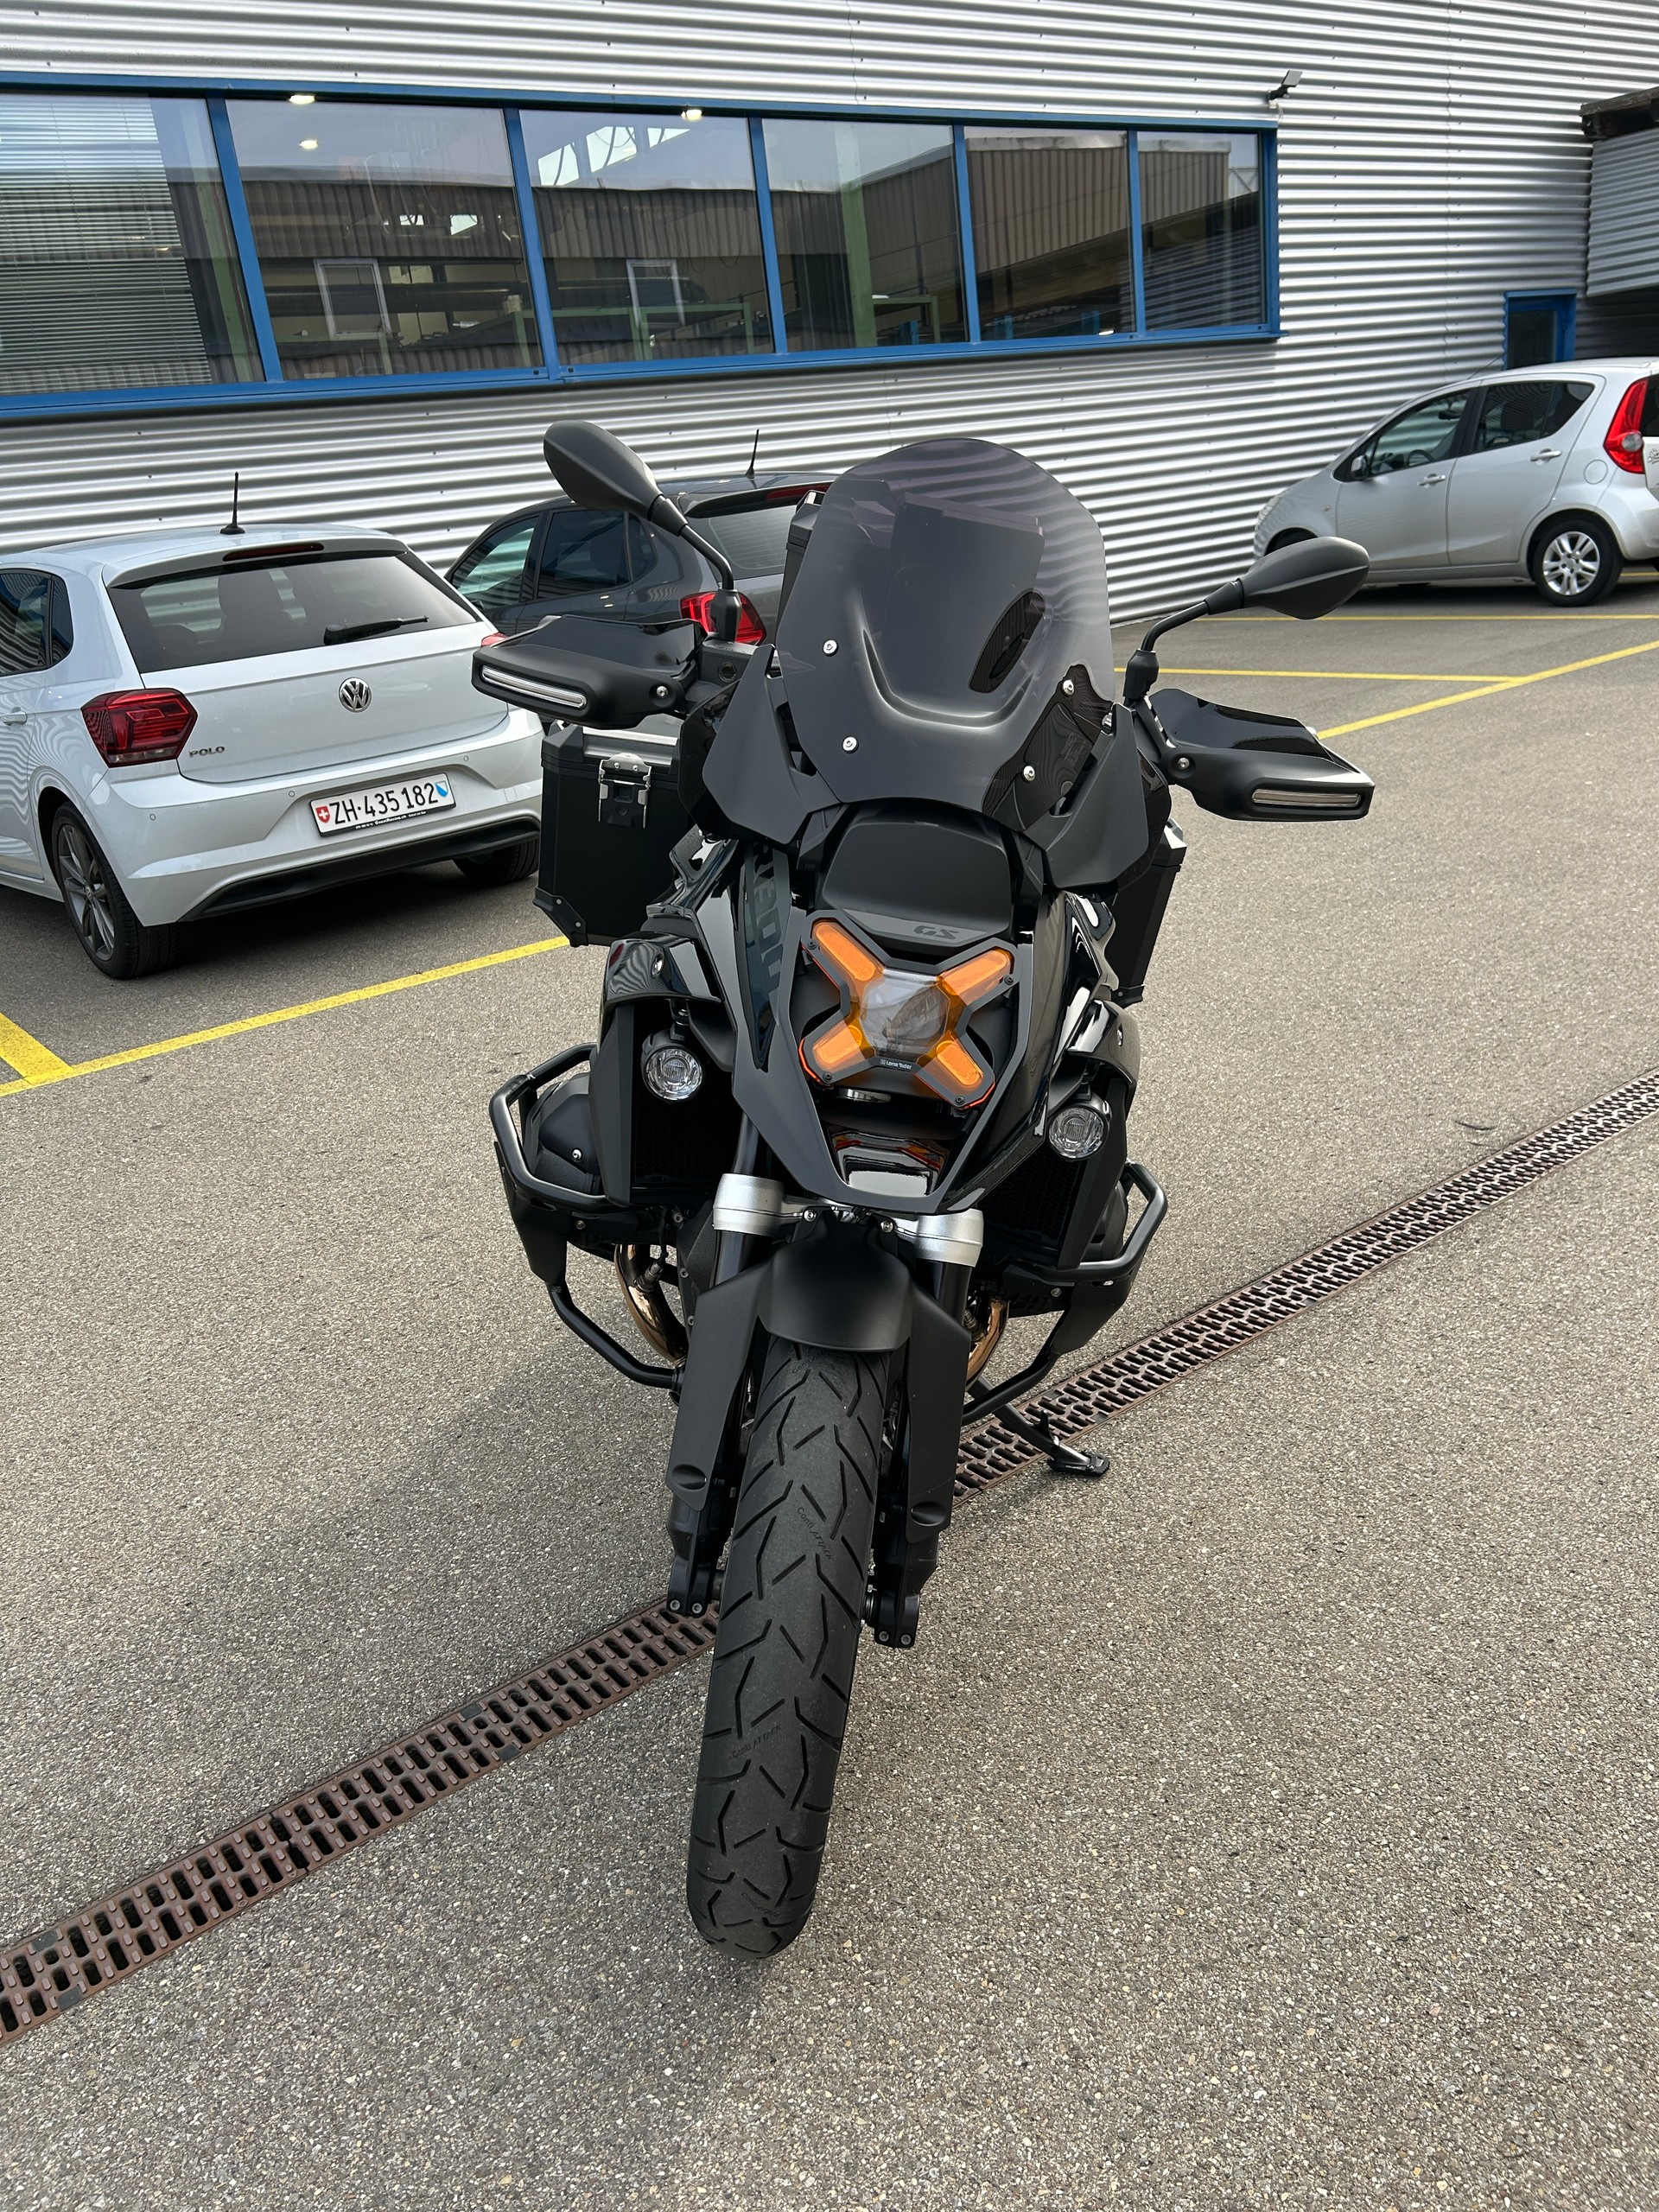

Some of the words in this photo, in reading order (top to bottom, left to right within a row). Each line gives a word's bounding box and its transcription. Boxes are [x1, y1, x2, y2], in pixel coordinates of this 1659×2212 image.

[189, 746, 225, 758] POLO
[913, 925, 960, 940] GS
[797, 1507, 815, 1529] Conti
